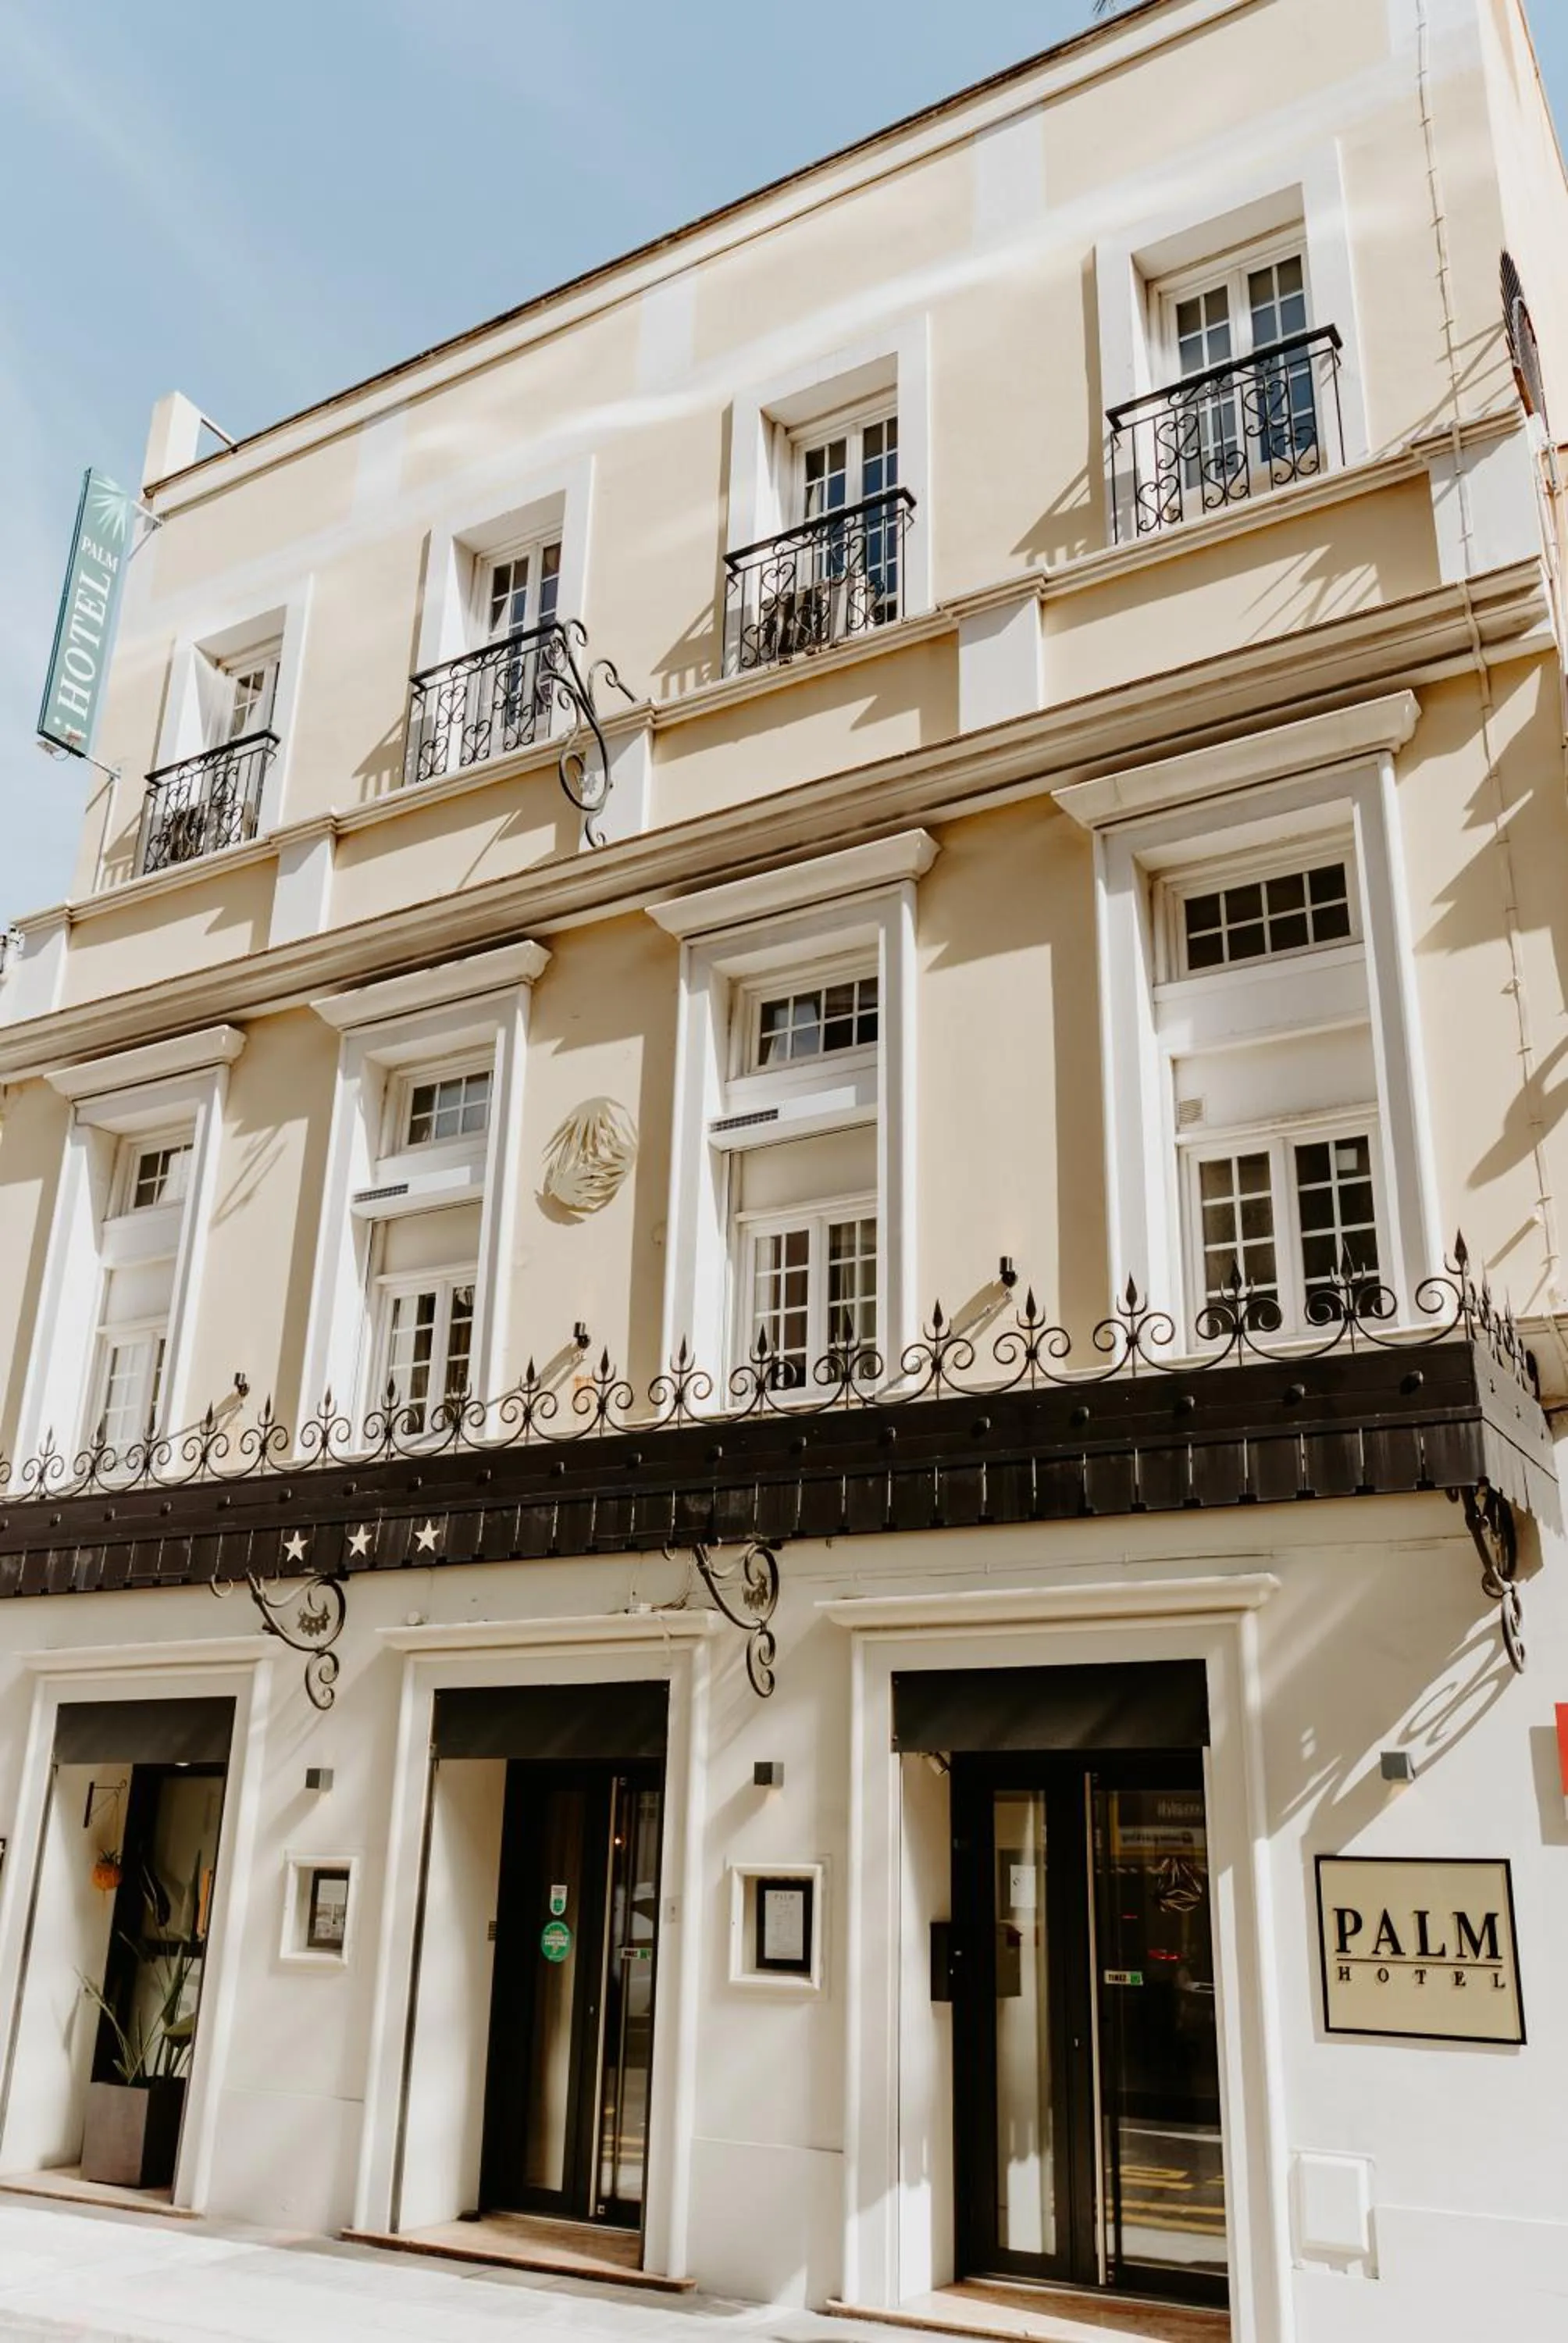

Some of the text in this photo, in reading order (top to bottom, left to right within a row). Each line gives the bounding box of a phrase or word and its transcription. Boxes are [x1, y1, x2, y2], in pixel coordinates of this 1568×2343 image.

[80, 535, 119, 572] PALM
[57, 569, 111, 721] HOTEL
[1333, 1908, 1502, 1960] PALM
[1338, 1966, 1506, 1988] HOTEL
